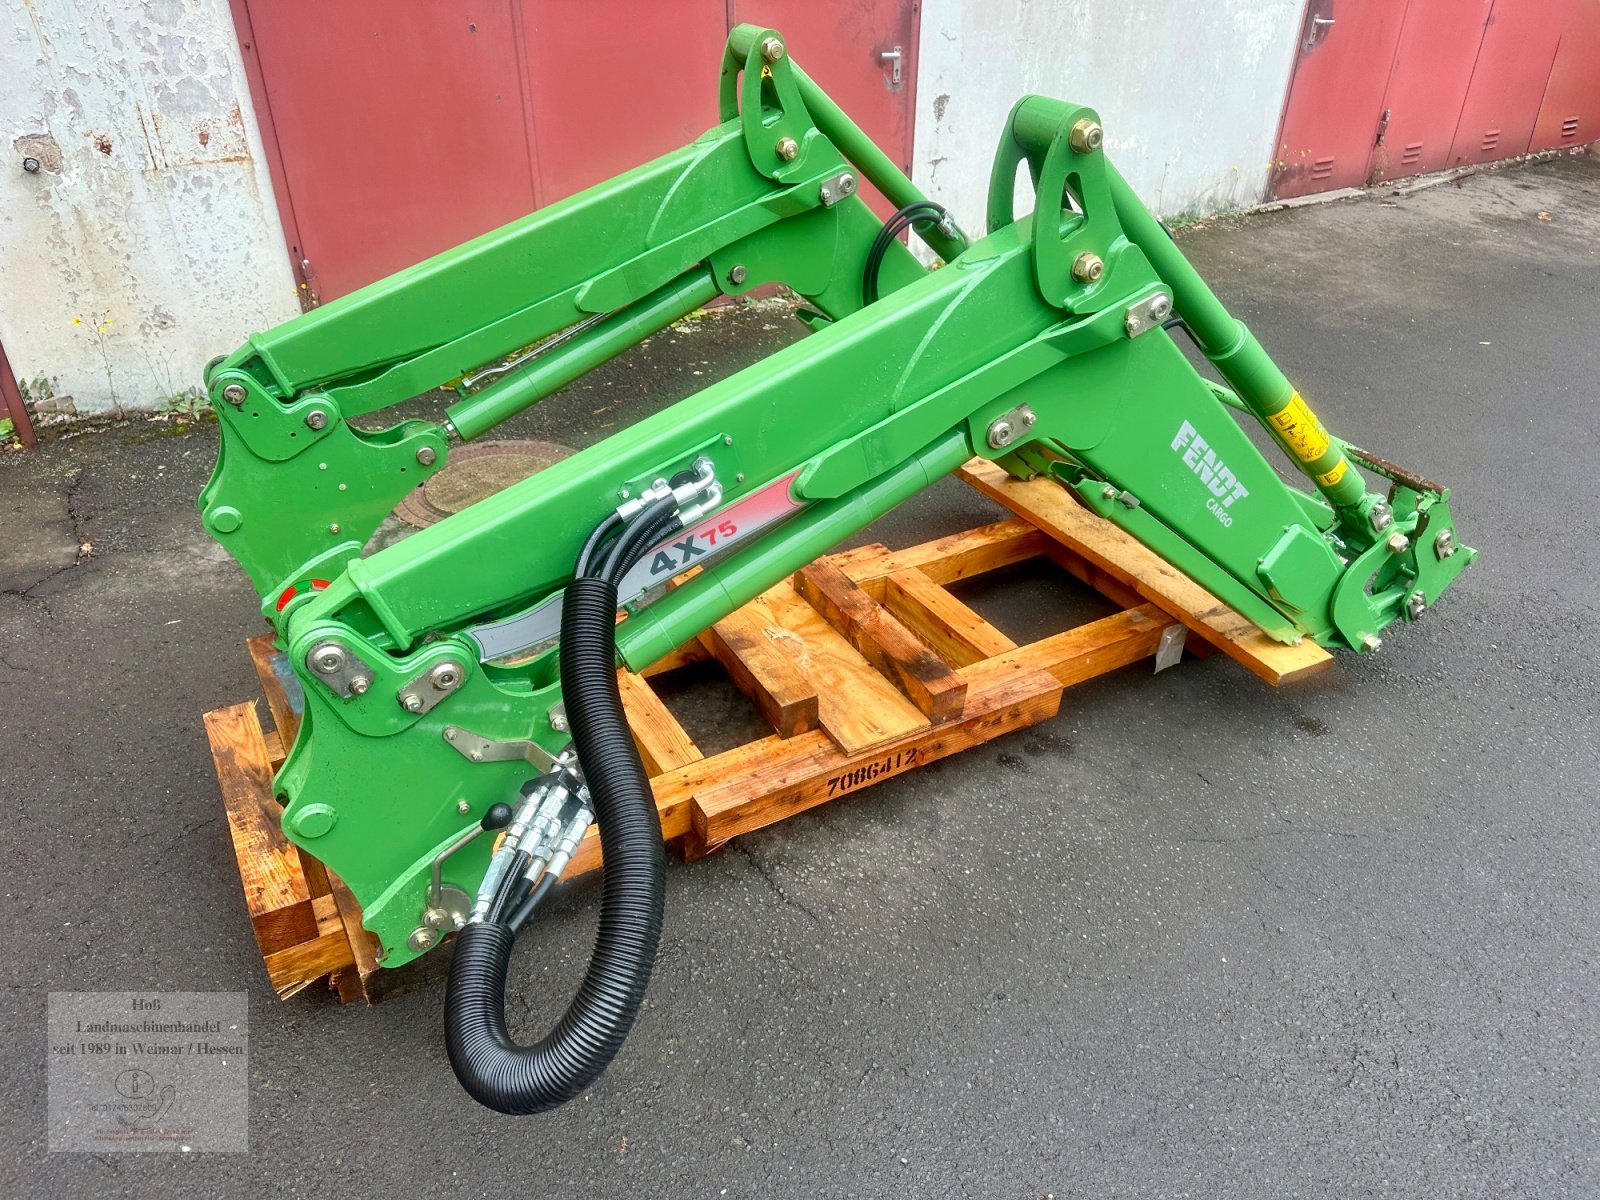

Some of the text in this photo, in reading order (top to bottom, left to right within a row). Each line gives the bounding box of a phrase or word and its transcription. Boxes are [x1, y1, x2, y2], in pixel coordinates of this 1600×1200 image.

[1171, 419, 1249, 508] FENDT
[1206, 498, 1232, 527] CARGO
[827, 748, 917, 797] 7086412
